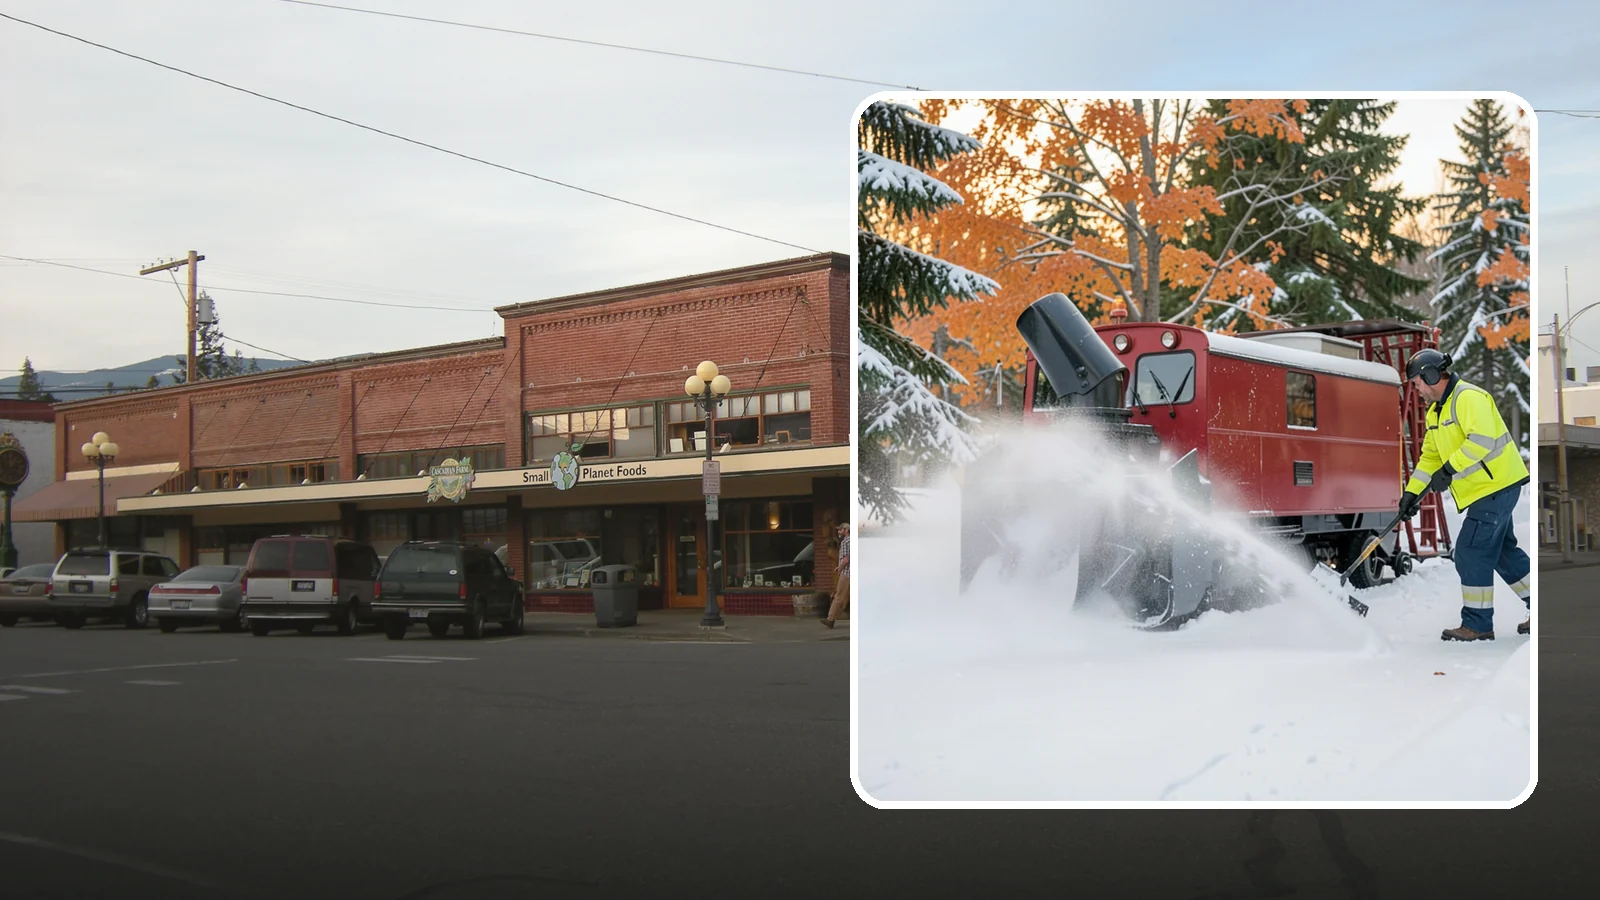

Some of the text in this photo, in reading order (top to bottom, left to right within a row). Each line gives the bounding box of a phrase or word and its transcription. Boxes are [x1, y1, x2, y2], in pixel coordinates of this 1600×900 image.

[523, 464, 647, 483] Small Planet Foods
